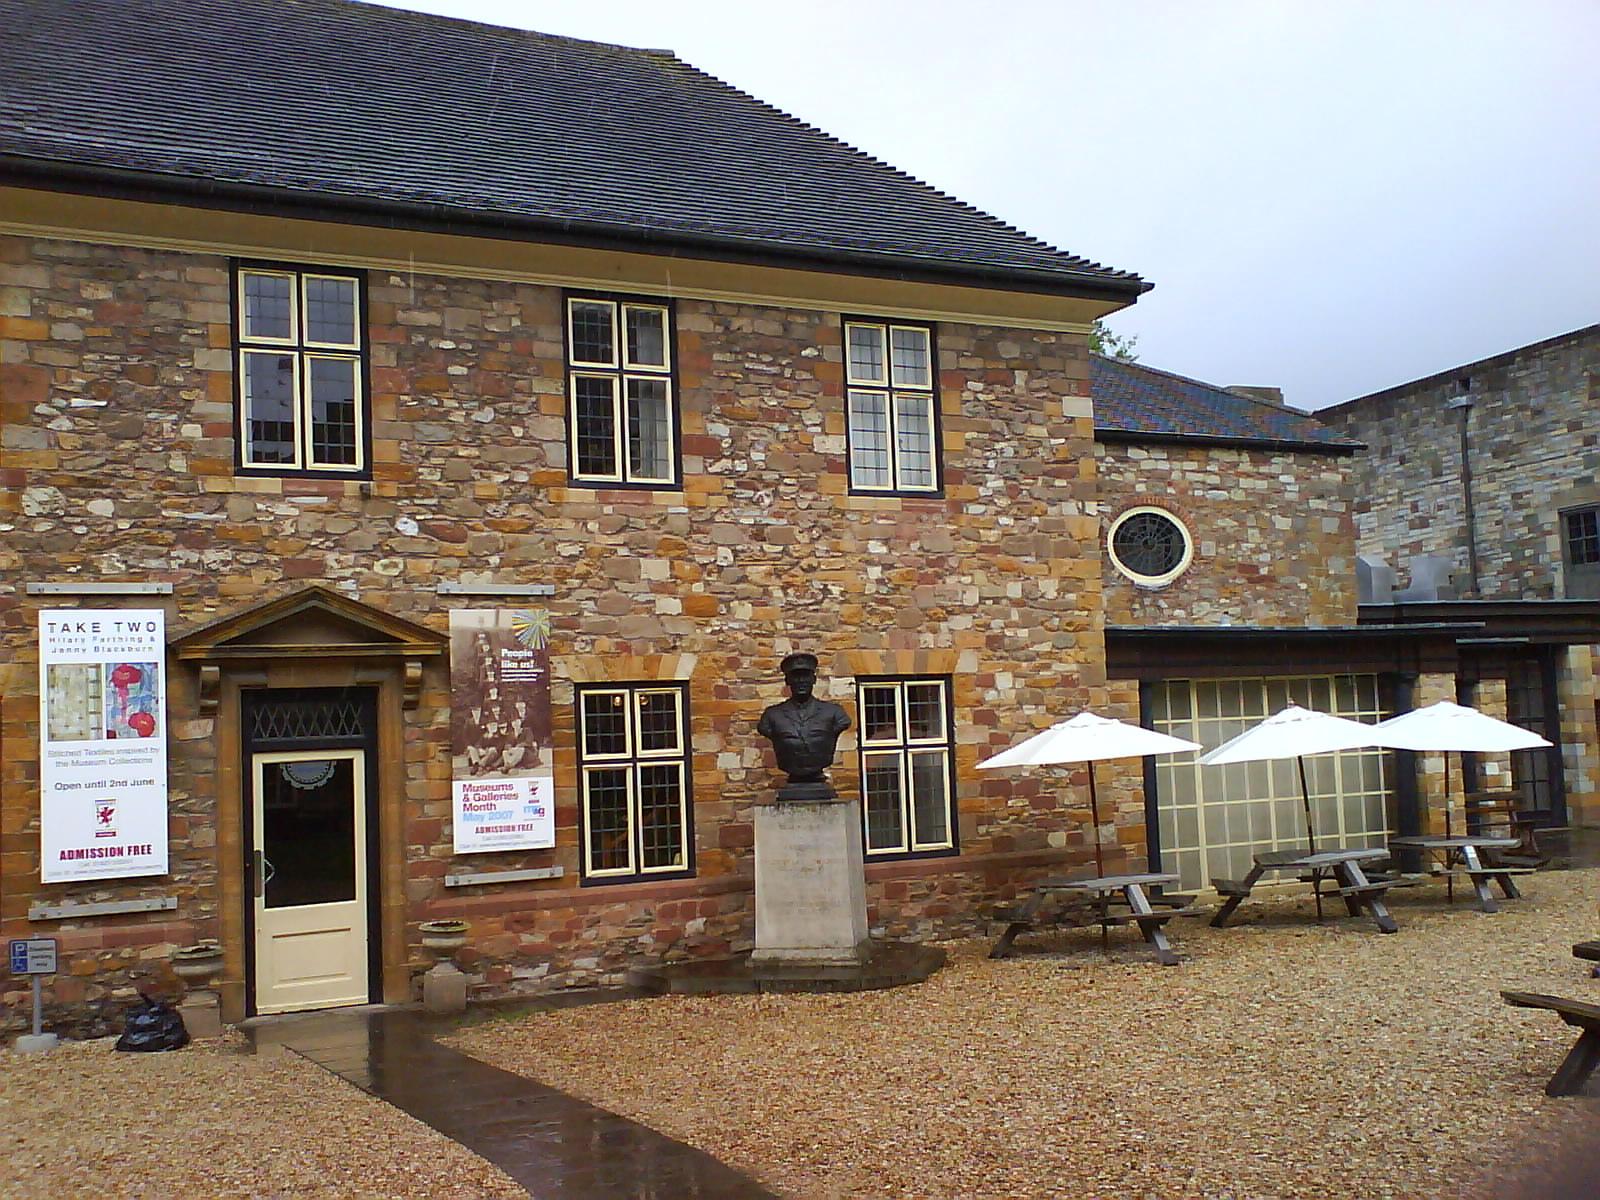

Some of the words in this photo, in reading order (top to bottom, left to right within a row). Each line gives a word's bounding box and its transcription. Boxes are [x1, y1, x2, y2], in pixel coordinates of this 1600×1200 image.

[47, 622, 102, 633] TAKE
[114, 621, 156, 633] TWO
[51, 646, 87, 654] Jenny
[94, 644, 154, 653] Blackburn
[501, 648, 533, 658] People
[501, 660, 518, 669] like
[71, 759, 107, 767] Museum
[54, 782, 82, 791] Open
[84, 780, 107, 789] until
[109, 779, 128, 788] 2nd
[130, 778, 155, 787] June
[462, 783, 514, 793] Museums
[462, 794, 470, 802] &
[473, 791, 519, 802] Galleries
[463, 803, 497, 812] Month
[463, 812, 485, 822] May
[488, 811, 513, 821] 2007
[475, 825, 515, 834] ADMISSION
[517, 824, 533, 832] FREE
[59, 846, 124, 861] ADMISSION
[127, 844, 153, 856] FREE
